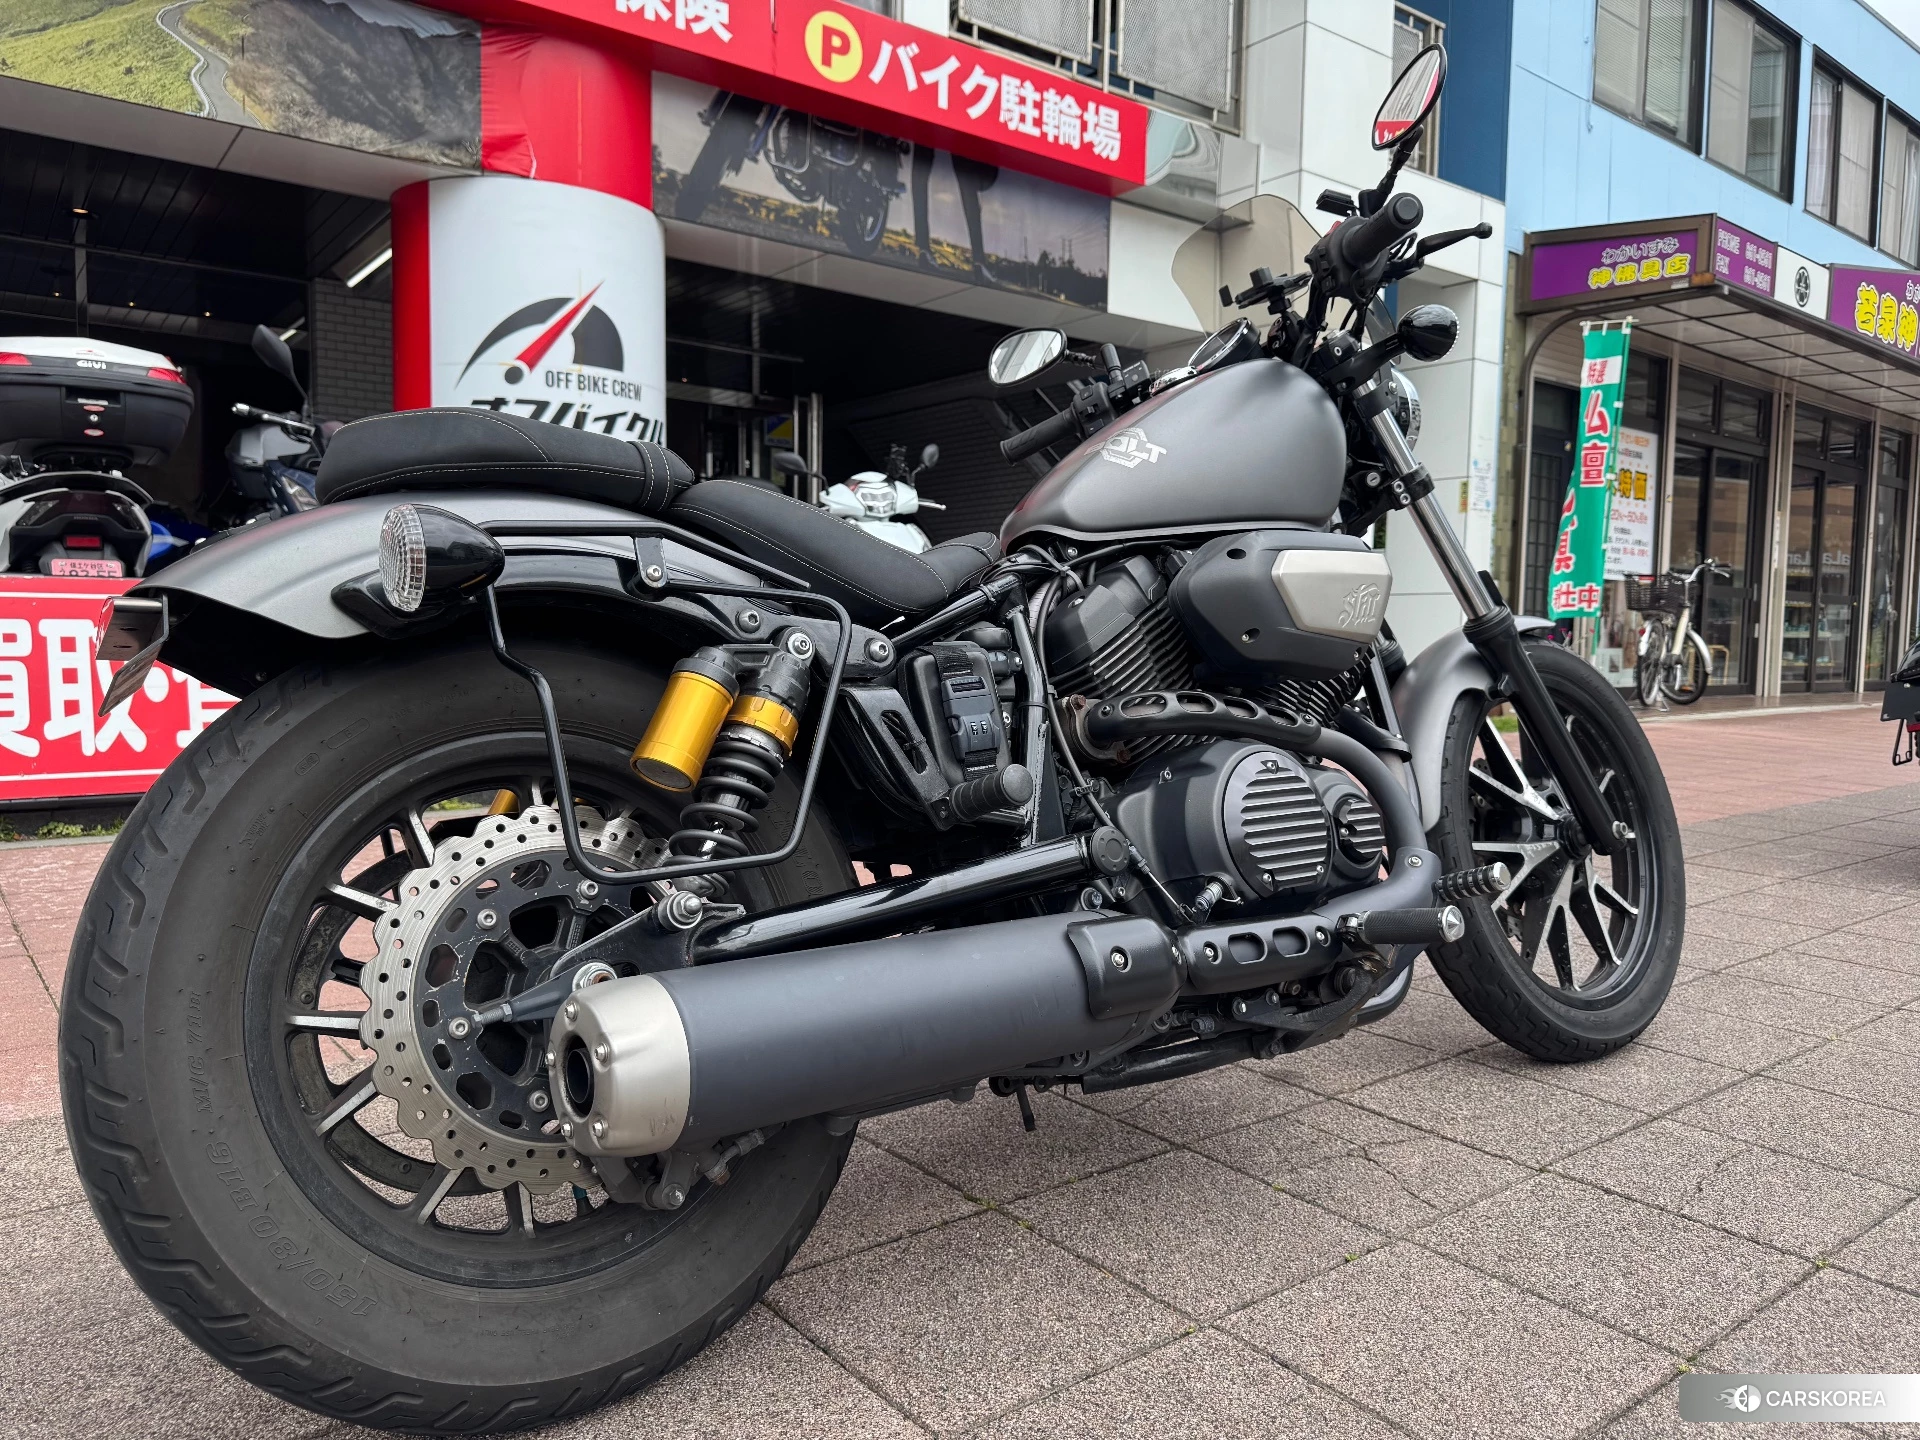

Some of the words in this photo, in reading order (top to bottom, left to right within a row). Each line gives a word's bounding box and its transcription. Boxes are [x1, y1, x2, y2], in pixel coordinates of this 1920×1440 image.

[821, 24, 851, 69] P
[868, 39, 1122, 162] バイク駐輪場
[76, 359, 107, 370] GIVI
[545, 370, 573, 389] OFF
[577, 373, 609, 395] BIKE
[612, 379, 642, 401] CREW
